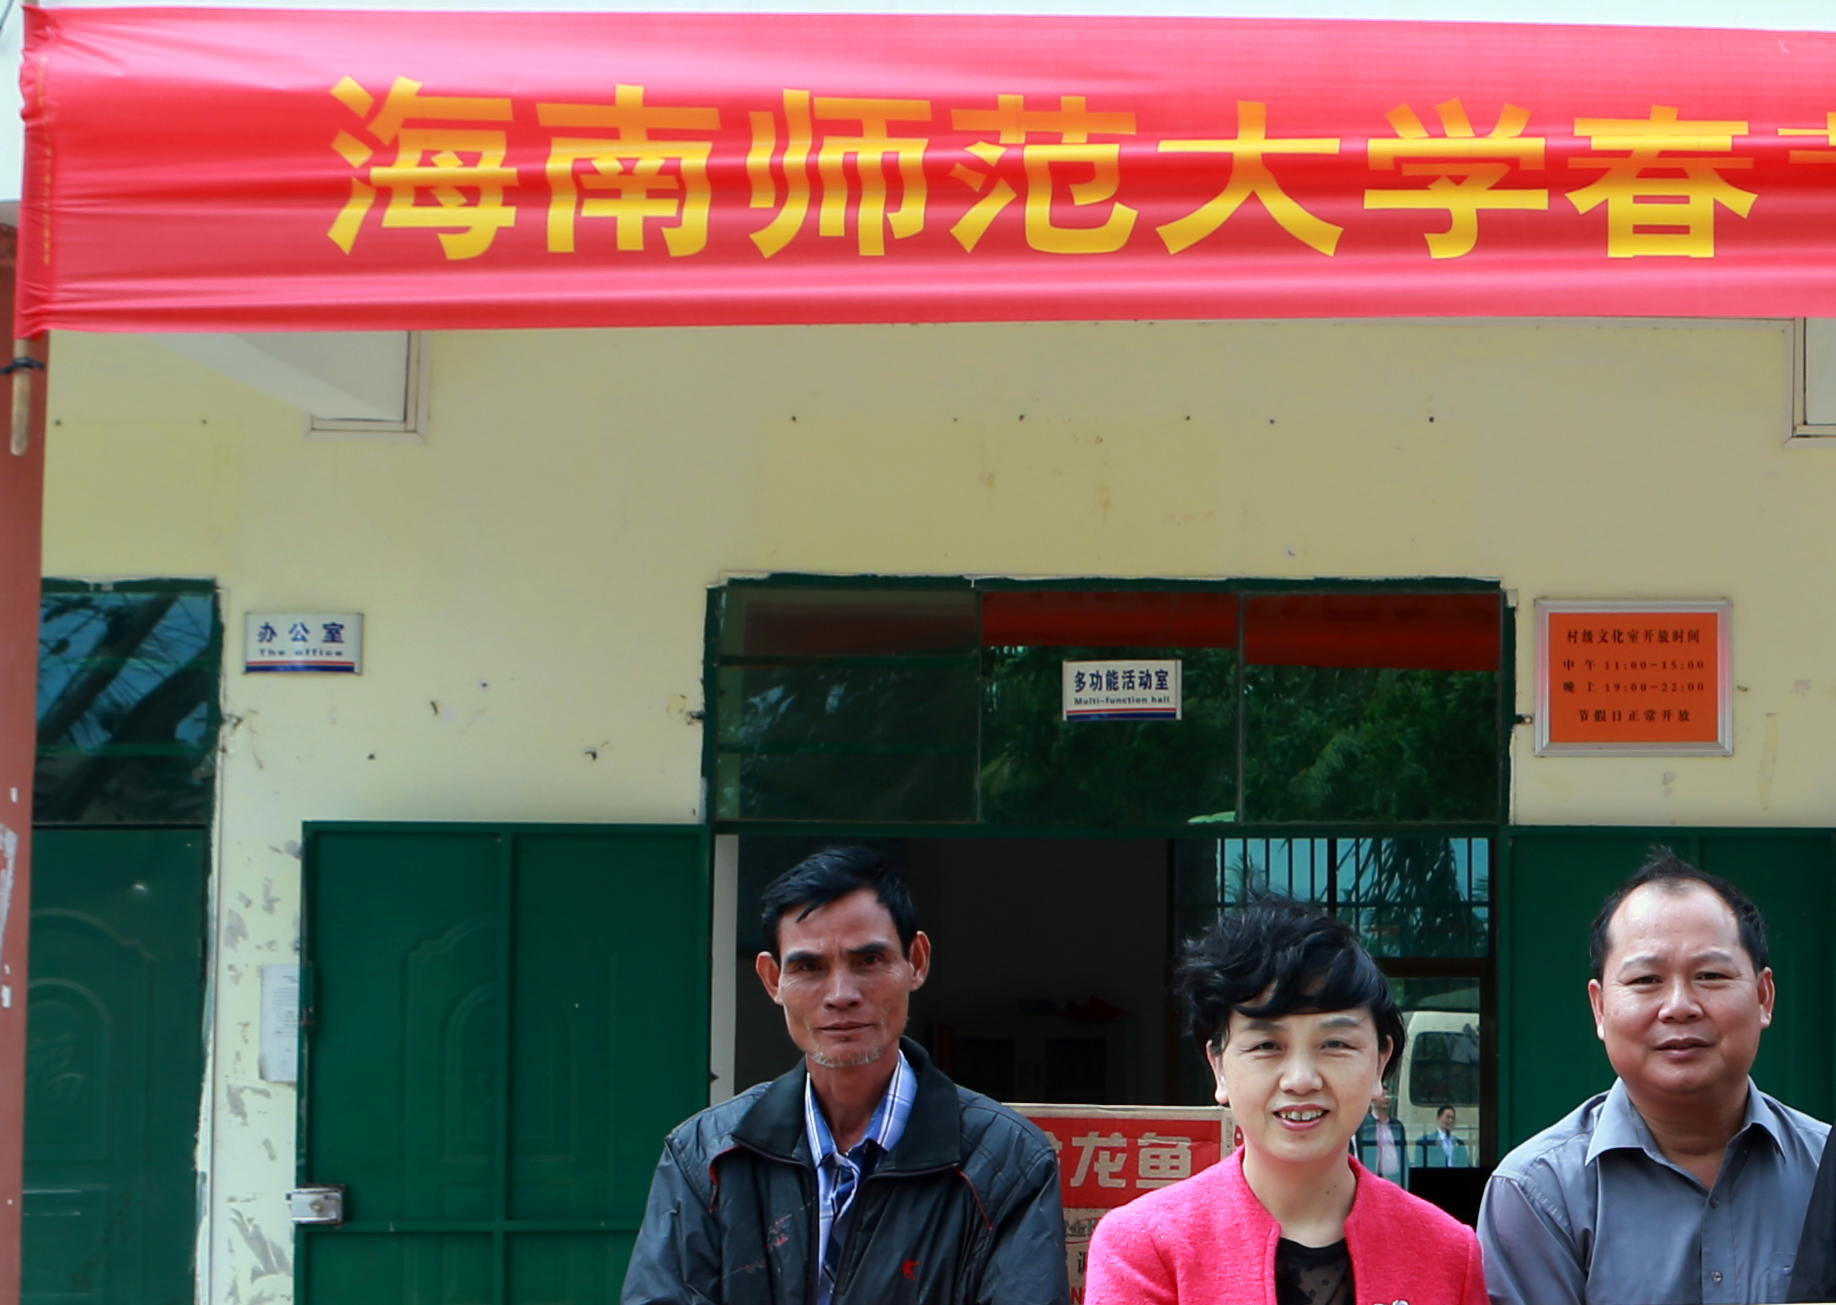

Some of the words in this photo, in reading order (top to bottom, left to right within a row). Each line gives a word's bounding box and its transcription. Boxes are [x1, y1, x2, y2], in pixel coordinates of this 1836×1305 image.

[258, 621, 344, 643] 办公室
[1567, 629, 1700, 644] 村级文化室开放时间
[259, 648, 285, 656] The
[295, 648, 342, 656] office
[1563, 659, 1596, 671] 中午
[1074, 669, 1169, 692] 多功能活动室
[1563, 681, 1596, 693] 晚上
[1074, 696, 1148, 705] Multi-function
[1151, 696, 1170, 704] hall
[1579, 709, 1690, 722] 节假日正常开放
